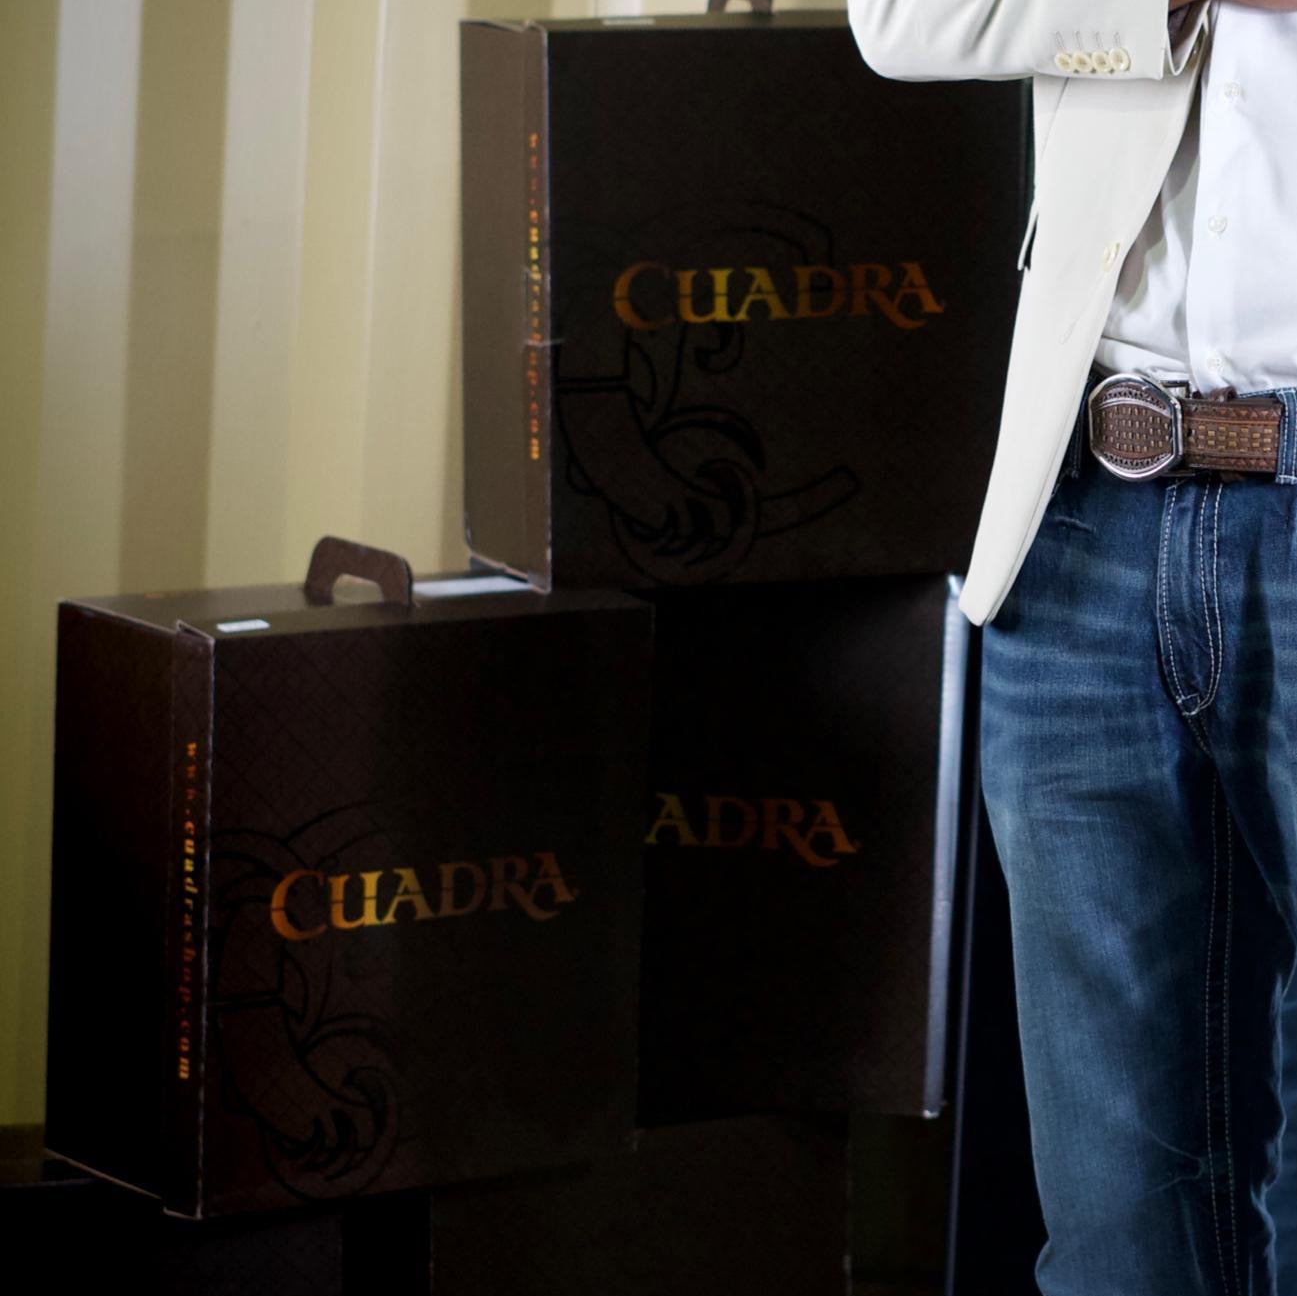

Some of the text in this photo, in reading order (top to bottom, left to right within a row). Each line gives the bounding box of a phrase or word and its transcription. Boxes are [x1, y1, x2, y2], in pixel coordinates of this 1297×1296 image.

[611, 258, 946, 330] CUADRA
[642, 791, 864, 868] ADRA
[270, 851, 580, 943] CUADRA
